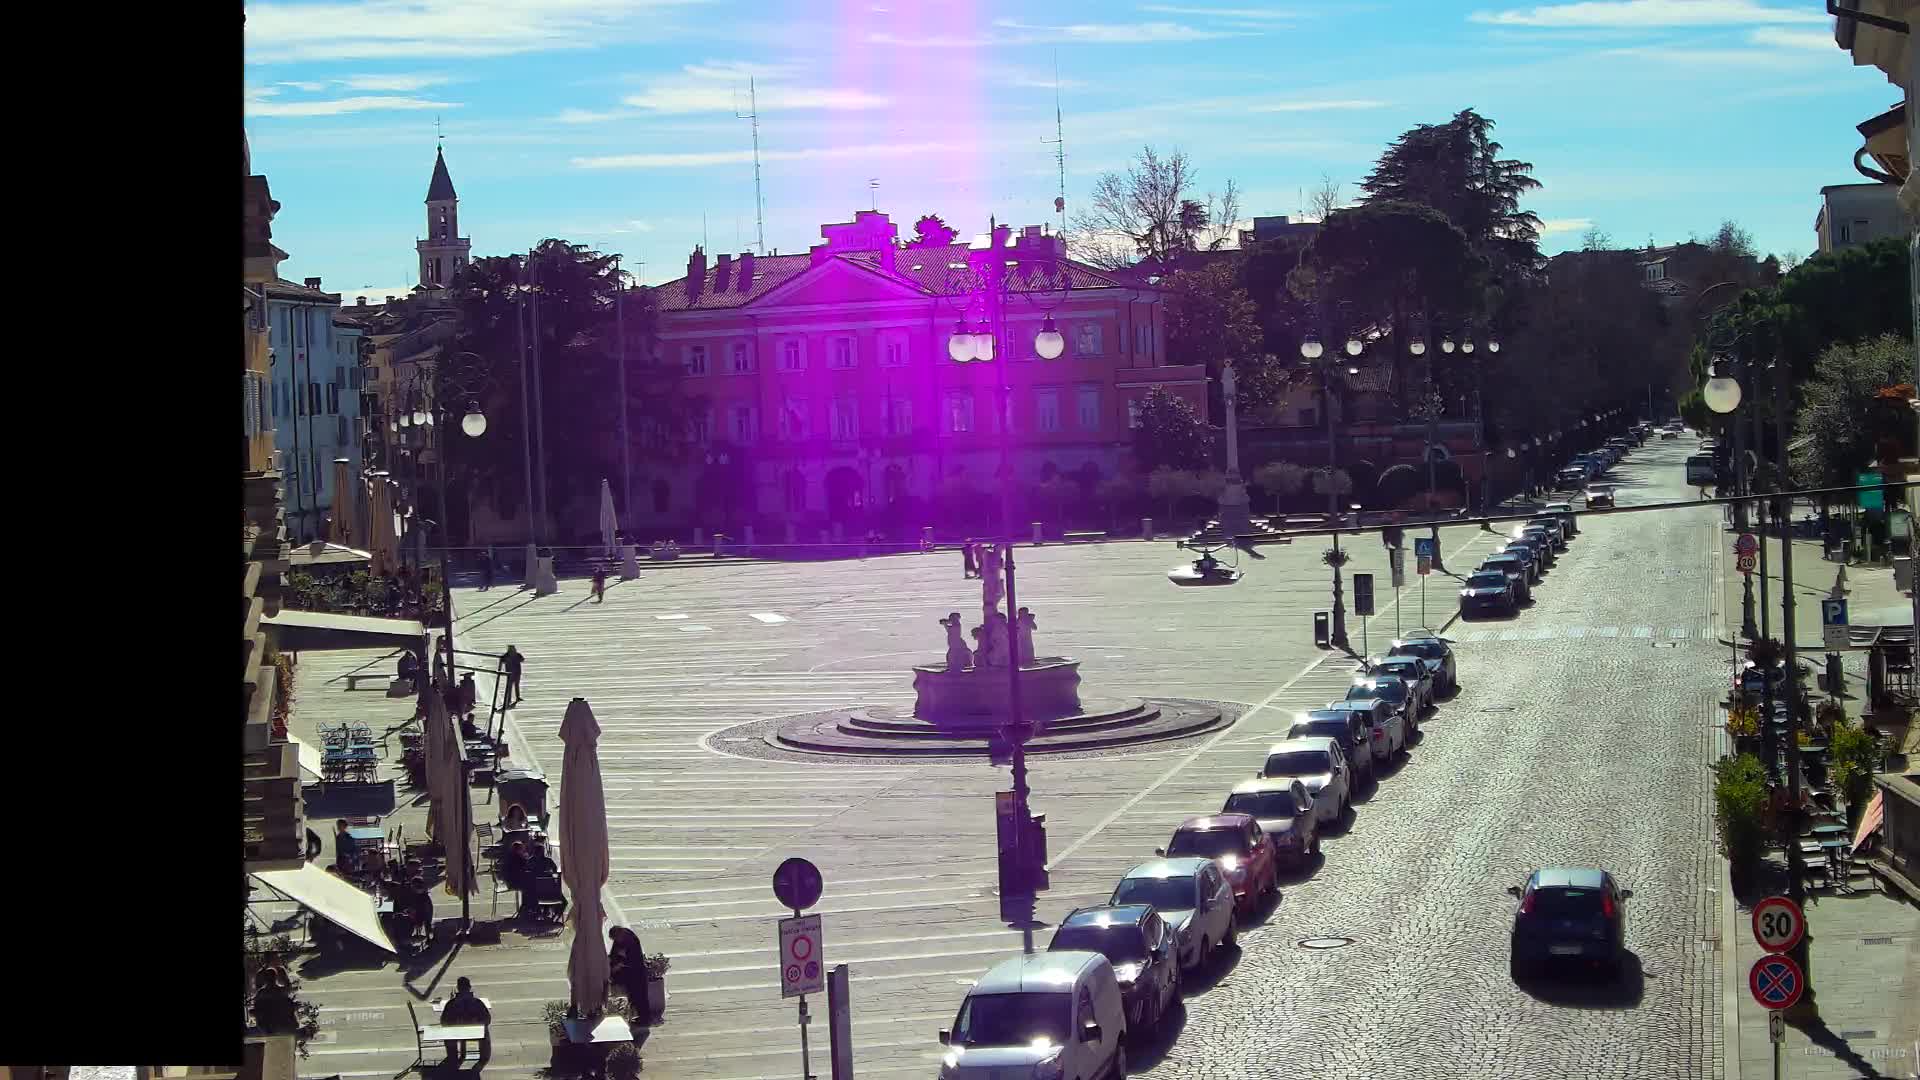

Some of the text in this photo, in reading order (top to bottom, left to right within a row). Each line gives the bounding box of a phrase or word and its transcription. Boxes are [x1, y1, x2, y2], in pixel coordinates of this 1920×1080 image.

[1742, 558, 1753, 567] 20
[1828, 603, 1841, 623] P
[1762, 912, 1791, 938] 30
